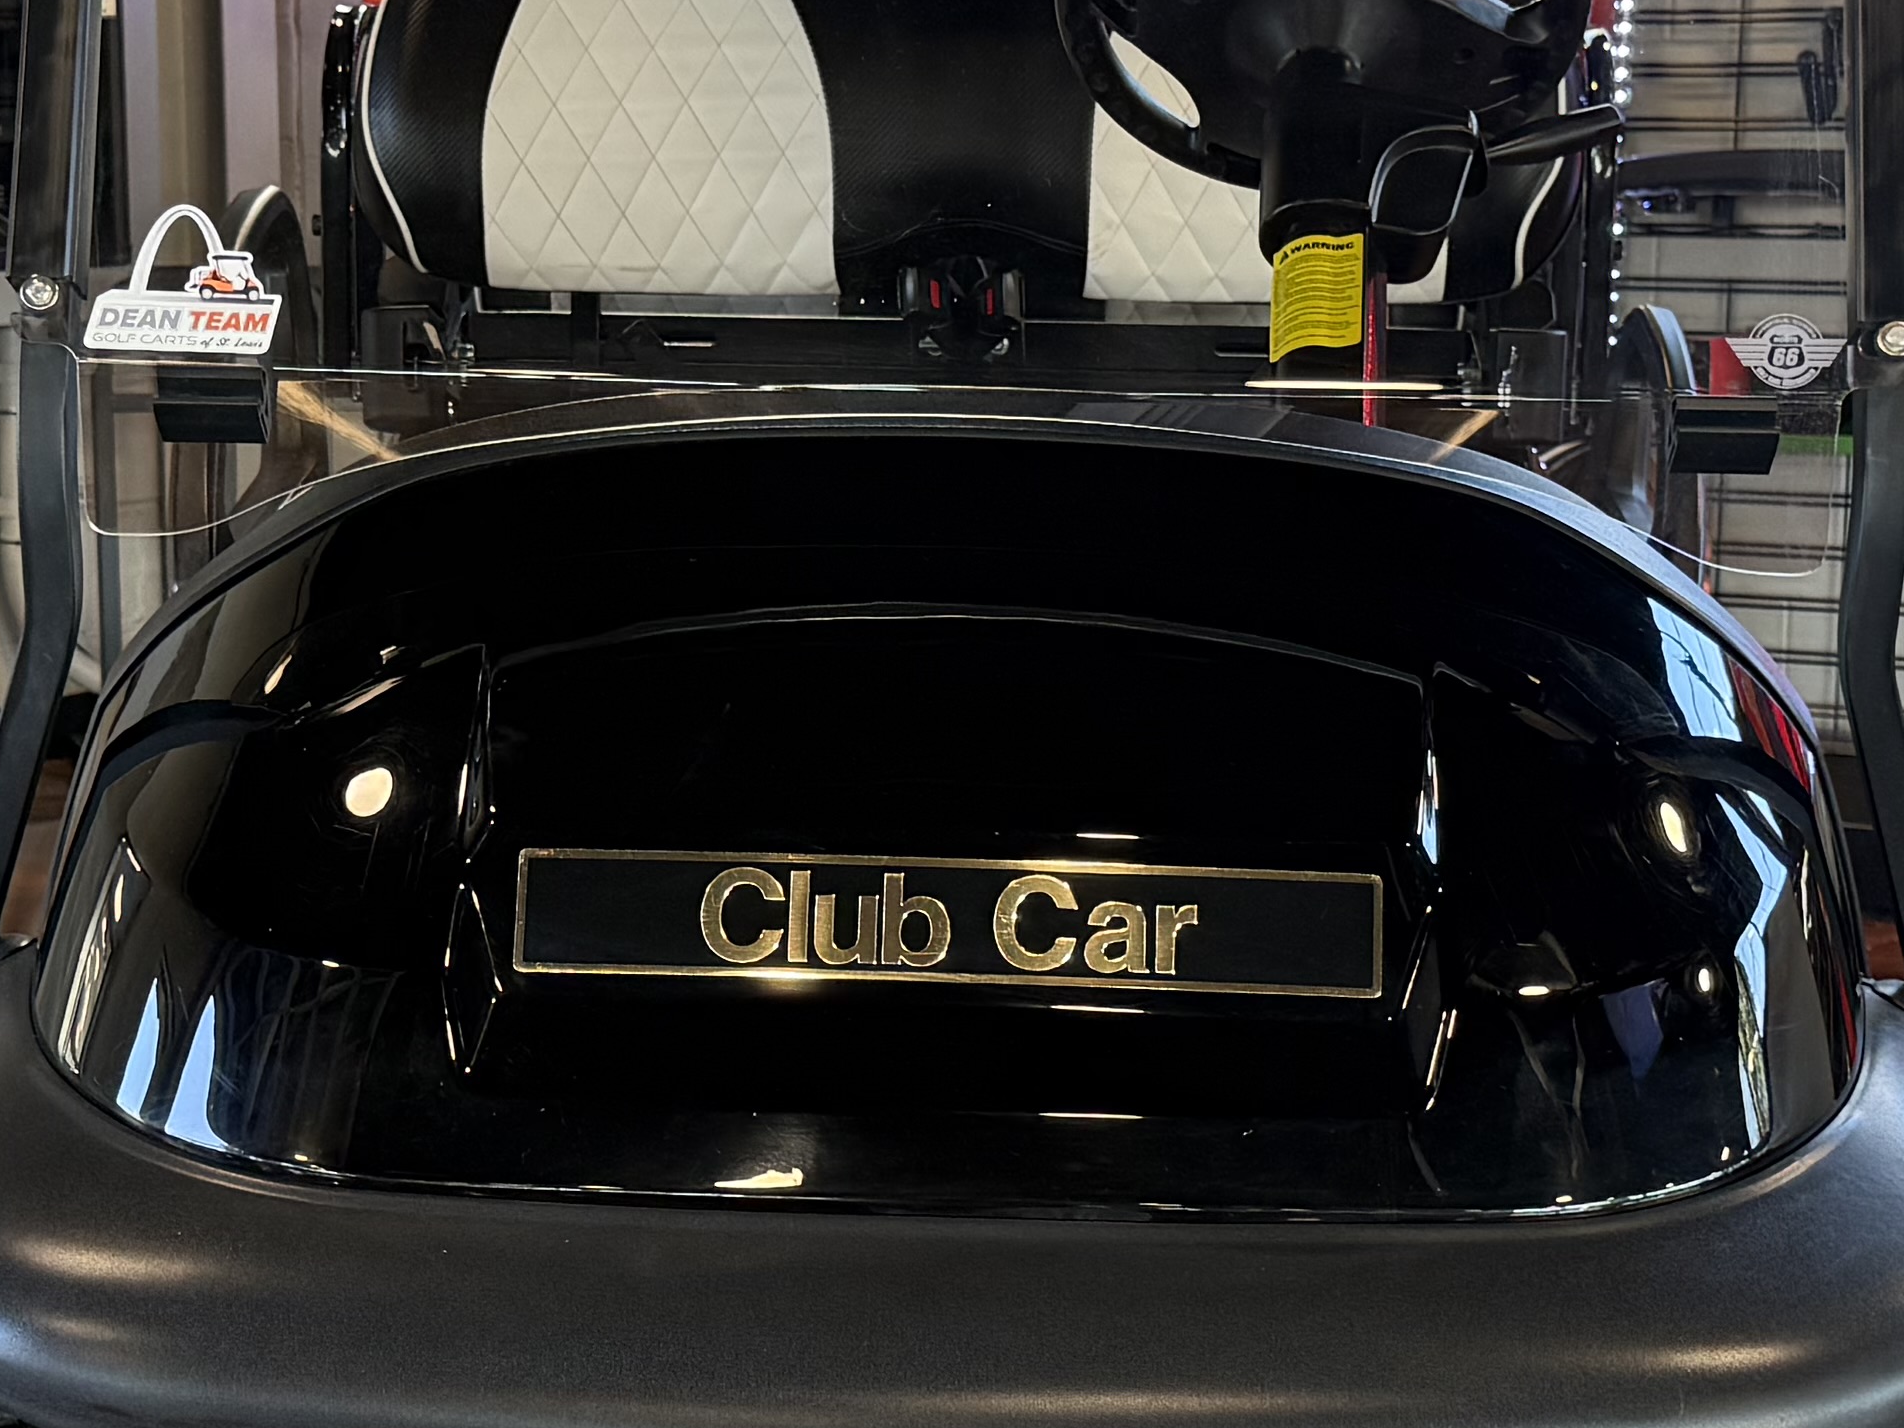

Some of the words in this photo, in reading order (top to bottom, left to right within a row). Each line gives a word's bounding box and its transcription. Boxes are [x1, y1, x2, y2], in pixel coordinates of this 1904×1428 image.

[1290, 241, 1355, 254] WARNING
[97, 307, 183, 330] DEAN
[189, 310, 272, 333] TEAM
[92, 332, 137, 344] GOLF
[140, 333, 198, 346] CARTS
[1772, 347, 1800, 367] 66
[699, 865, 953, 968] Club
[992, 873, 1200, 976] Car
